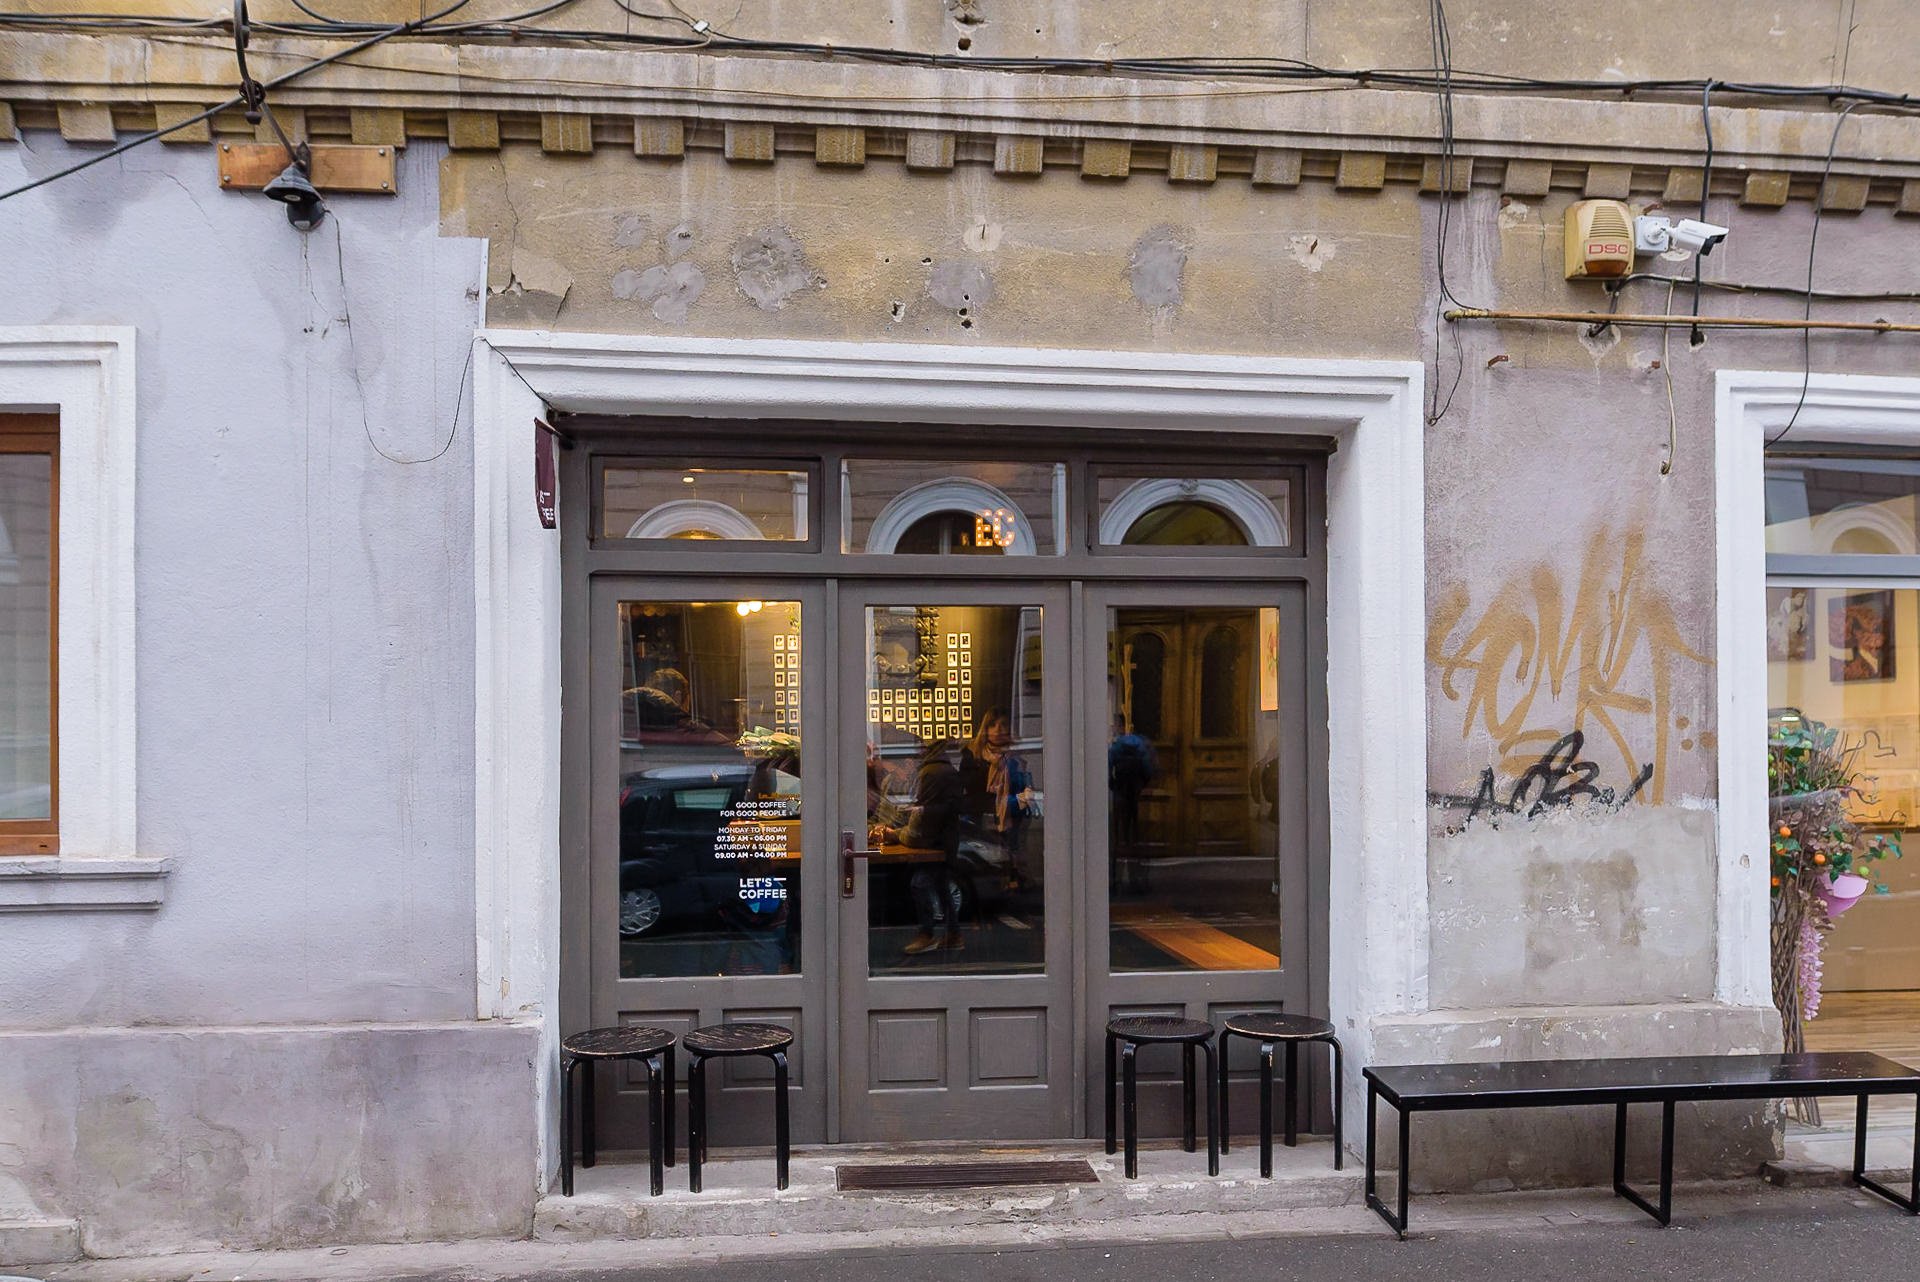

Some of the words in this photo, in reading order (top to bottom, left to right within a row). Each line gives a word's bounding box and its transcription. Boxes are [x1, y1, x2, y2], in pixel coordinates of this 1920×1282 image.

[1588, 244, 1628, 255] DSC
[735, 801, 758, 809] GOOD
[758, 801, 787, 809] COFFEE
[720, 810, 735, 818] FOR
[759, 809, 787, 817] PEOPLE
[750, 826, 760, 834] TO
[716, 835, 736, 843] 07.30
[714, 843, 751, 851] SATURDAY
[739, 878, 772, 888] LET'S
[738, 889, 787, 899] COFFEE
